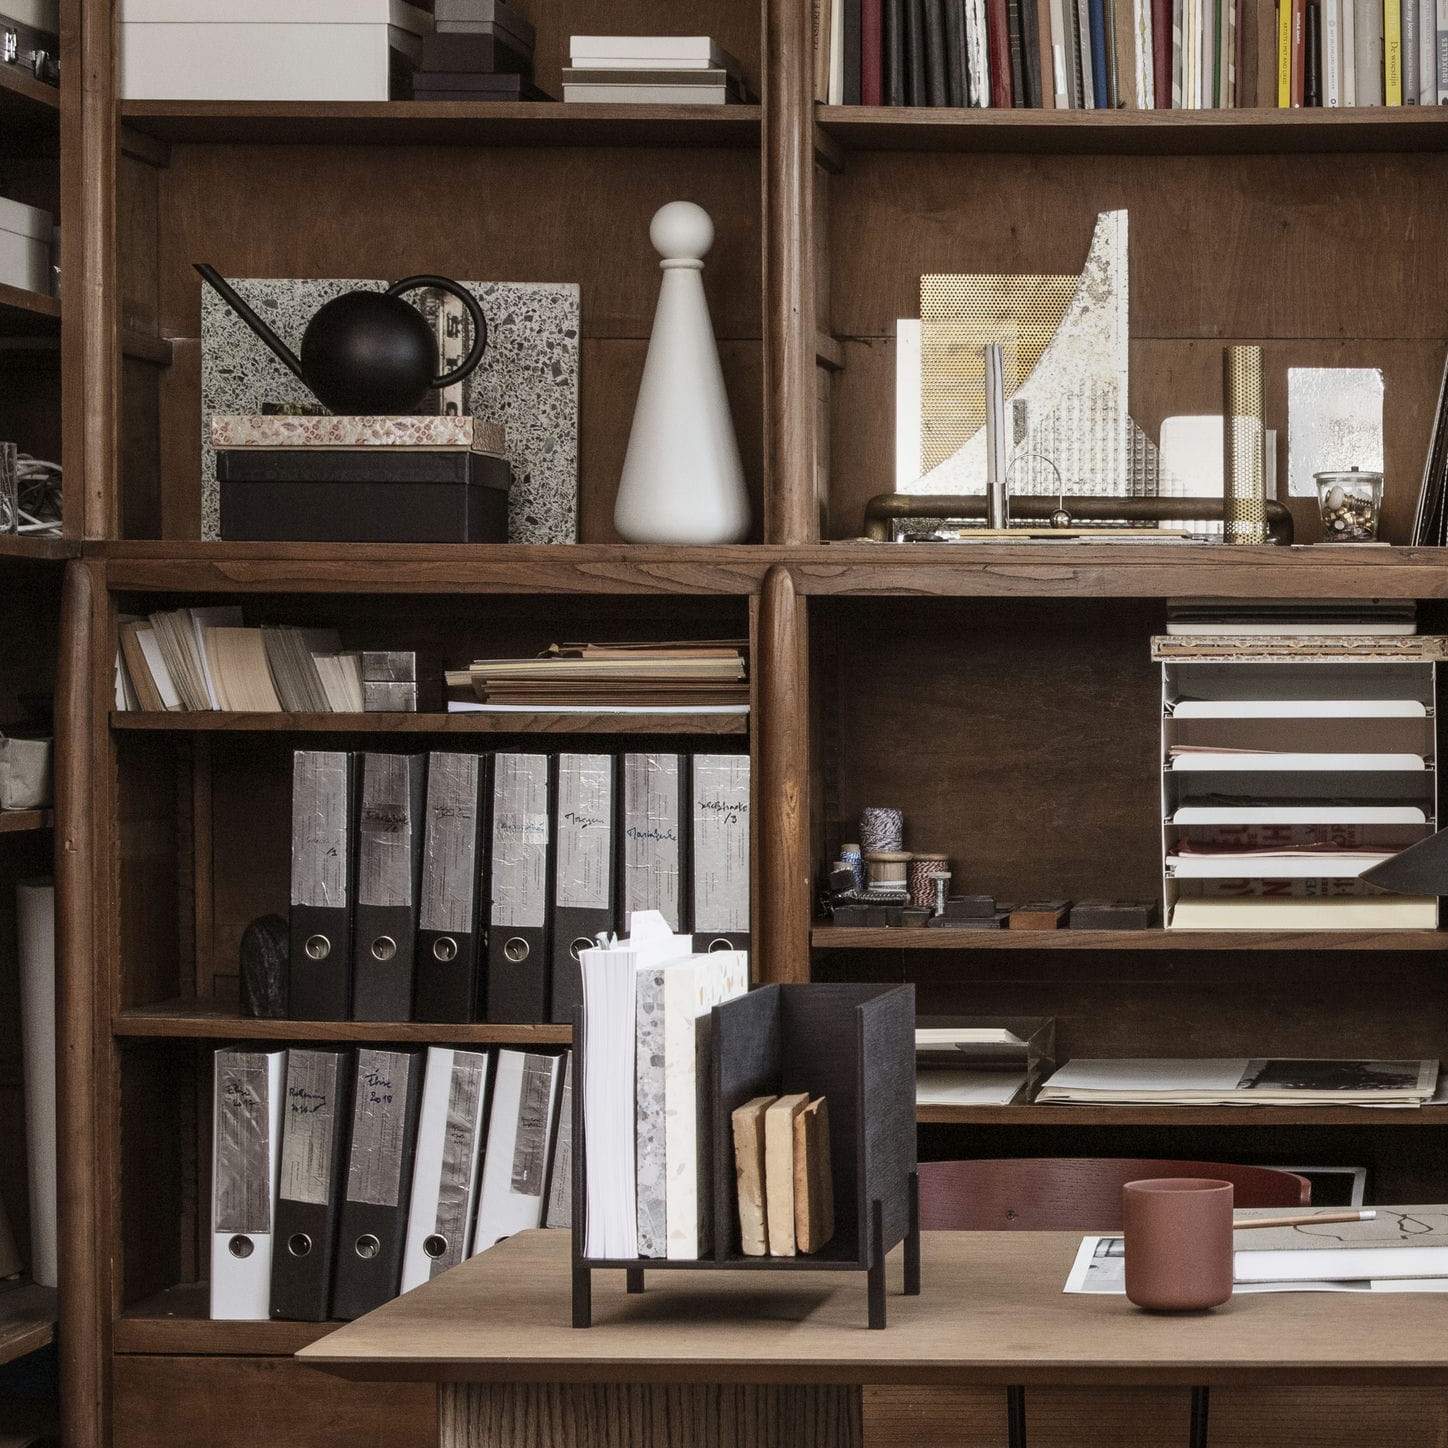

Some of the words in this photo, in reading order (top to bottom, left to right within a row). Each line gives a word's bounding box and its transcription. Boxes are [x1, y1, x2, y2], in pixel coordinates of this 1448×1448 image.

[1405, 11, 1413, 21] my
[1390, 41, 1398, 53] De
[1389, 55, 1398, 87] woestijn
[370, 1090, 393, 1104] 2018
